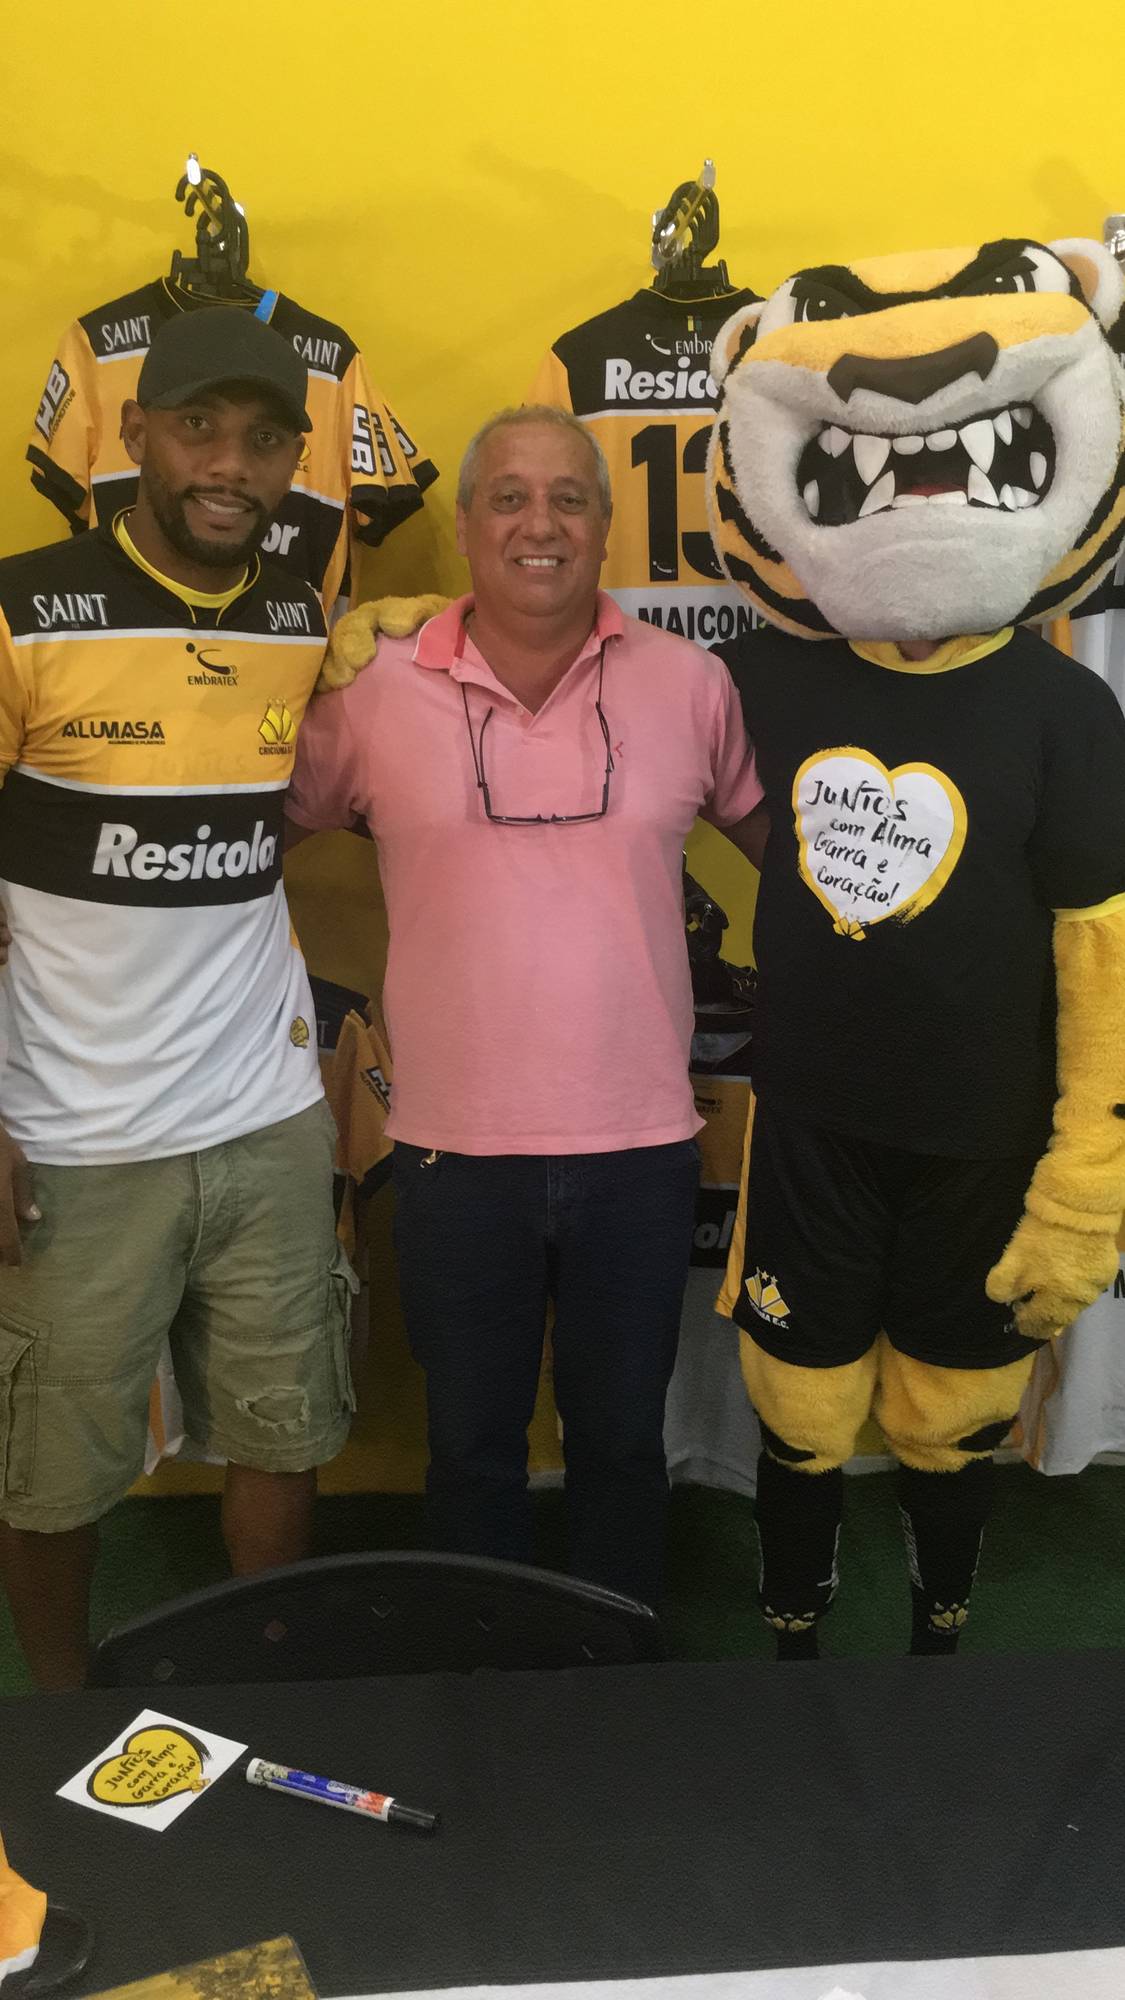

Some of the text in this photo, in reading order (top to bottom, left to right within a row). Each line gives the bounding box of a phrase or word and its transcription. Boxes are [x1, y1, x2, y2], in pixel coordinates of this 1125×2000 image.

[101, 315, 151, 352] SAINT
[675, 332, 713, 355] EMbR
[293, 334, 342, 372] SAINT
[33, 593, 110, 629] SAINT
[266, 600, 311, 634] SAINT
[62, 720, 165, 738] ALUMASA
[813, 831, 889, 874] Garra e
[830, 816, 932, 858] com Alma
[817, 865, 900, 907] Coração!
[127, 1743, 178, 1788] com Alma
[132, 1771, 168, 1799] Garra
